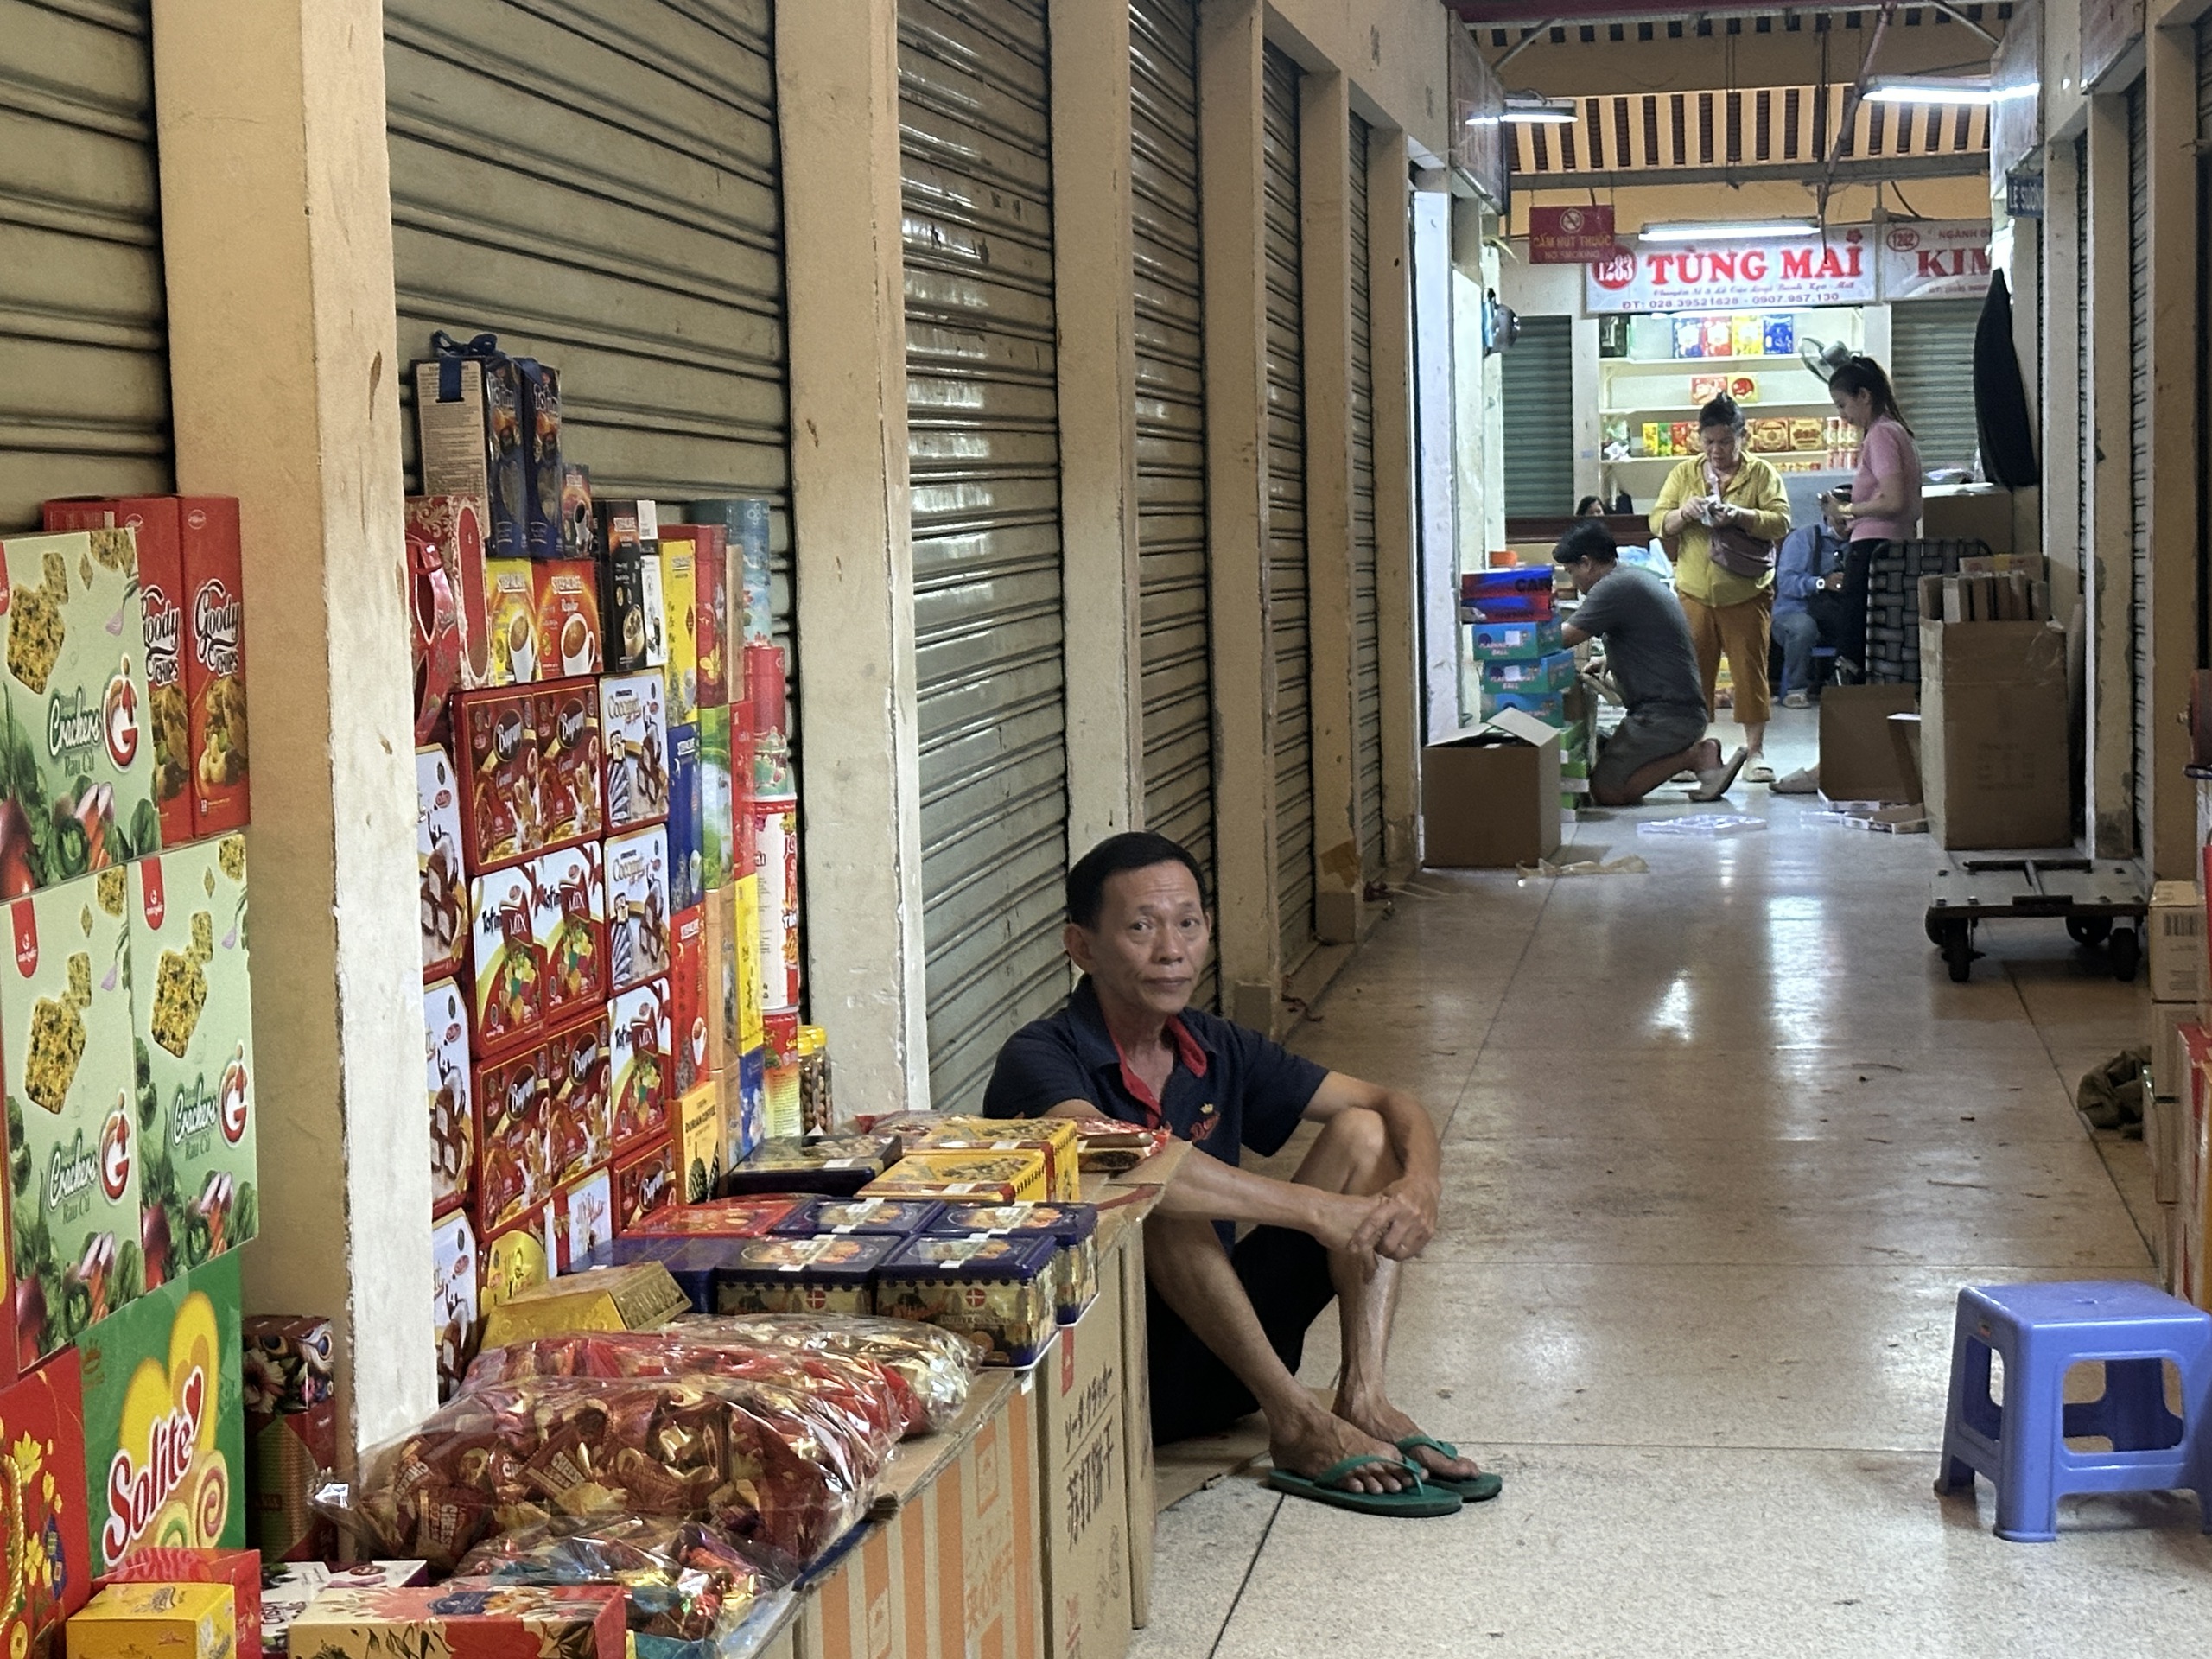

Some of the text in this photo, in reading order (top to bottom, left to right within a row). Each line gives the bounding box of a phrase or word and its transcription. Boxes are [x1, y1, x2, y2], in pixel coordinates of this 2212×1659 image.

[1599, 254, 1634, 282] 1283
[1780, 242, 1863, 280] MAI
[194, 578, 240, 671] Goody
[102, 1404, 197, 1567] Solite
[550, 1452, 588, 1484] CHEES
